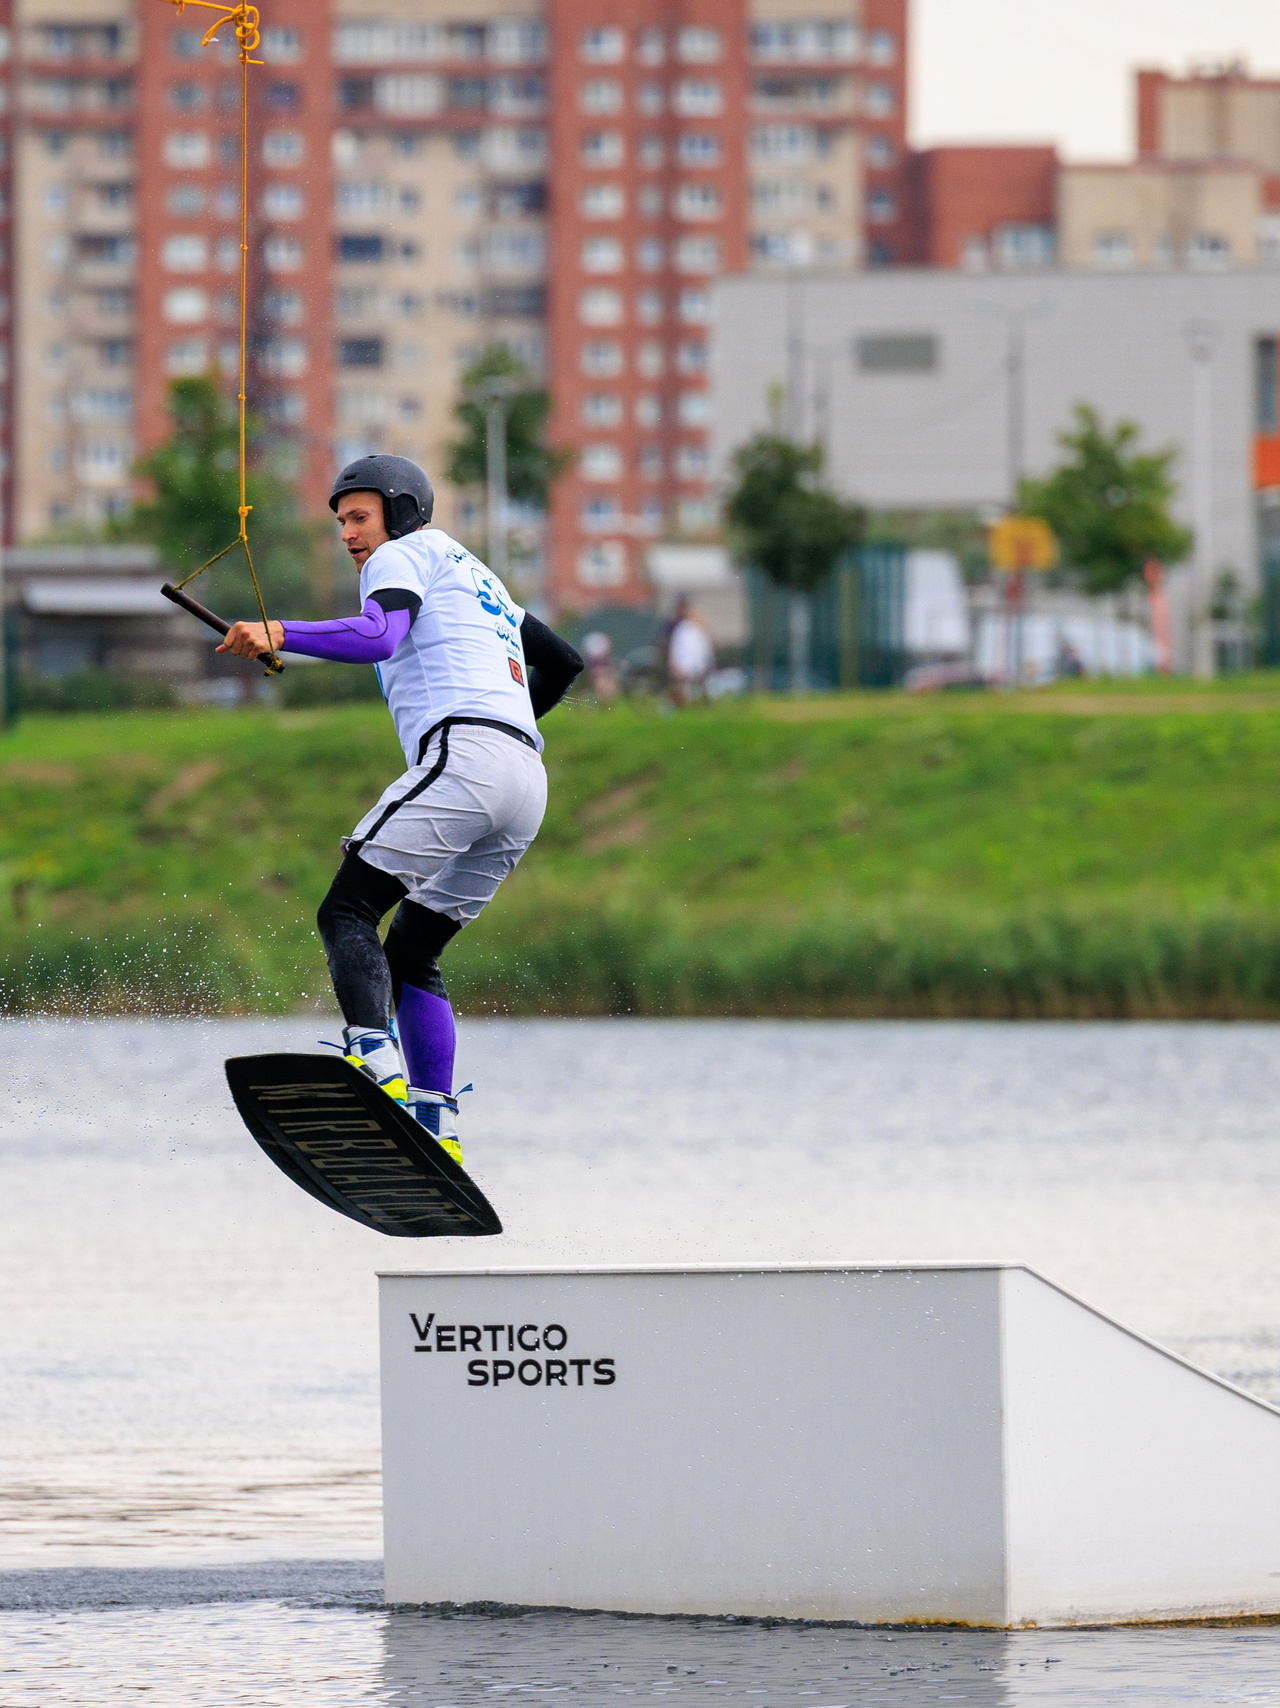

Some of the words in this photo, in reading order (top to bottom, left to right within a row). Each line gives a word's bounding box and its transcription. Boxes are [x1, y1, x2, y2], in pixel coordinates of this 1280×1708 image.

[248, 1082, 472, 1224] MIRBOARDS
[409, 1313, 568, 1352] VERTIGO
[467, 1358, 616, 1387] SPORTS
